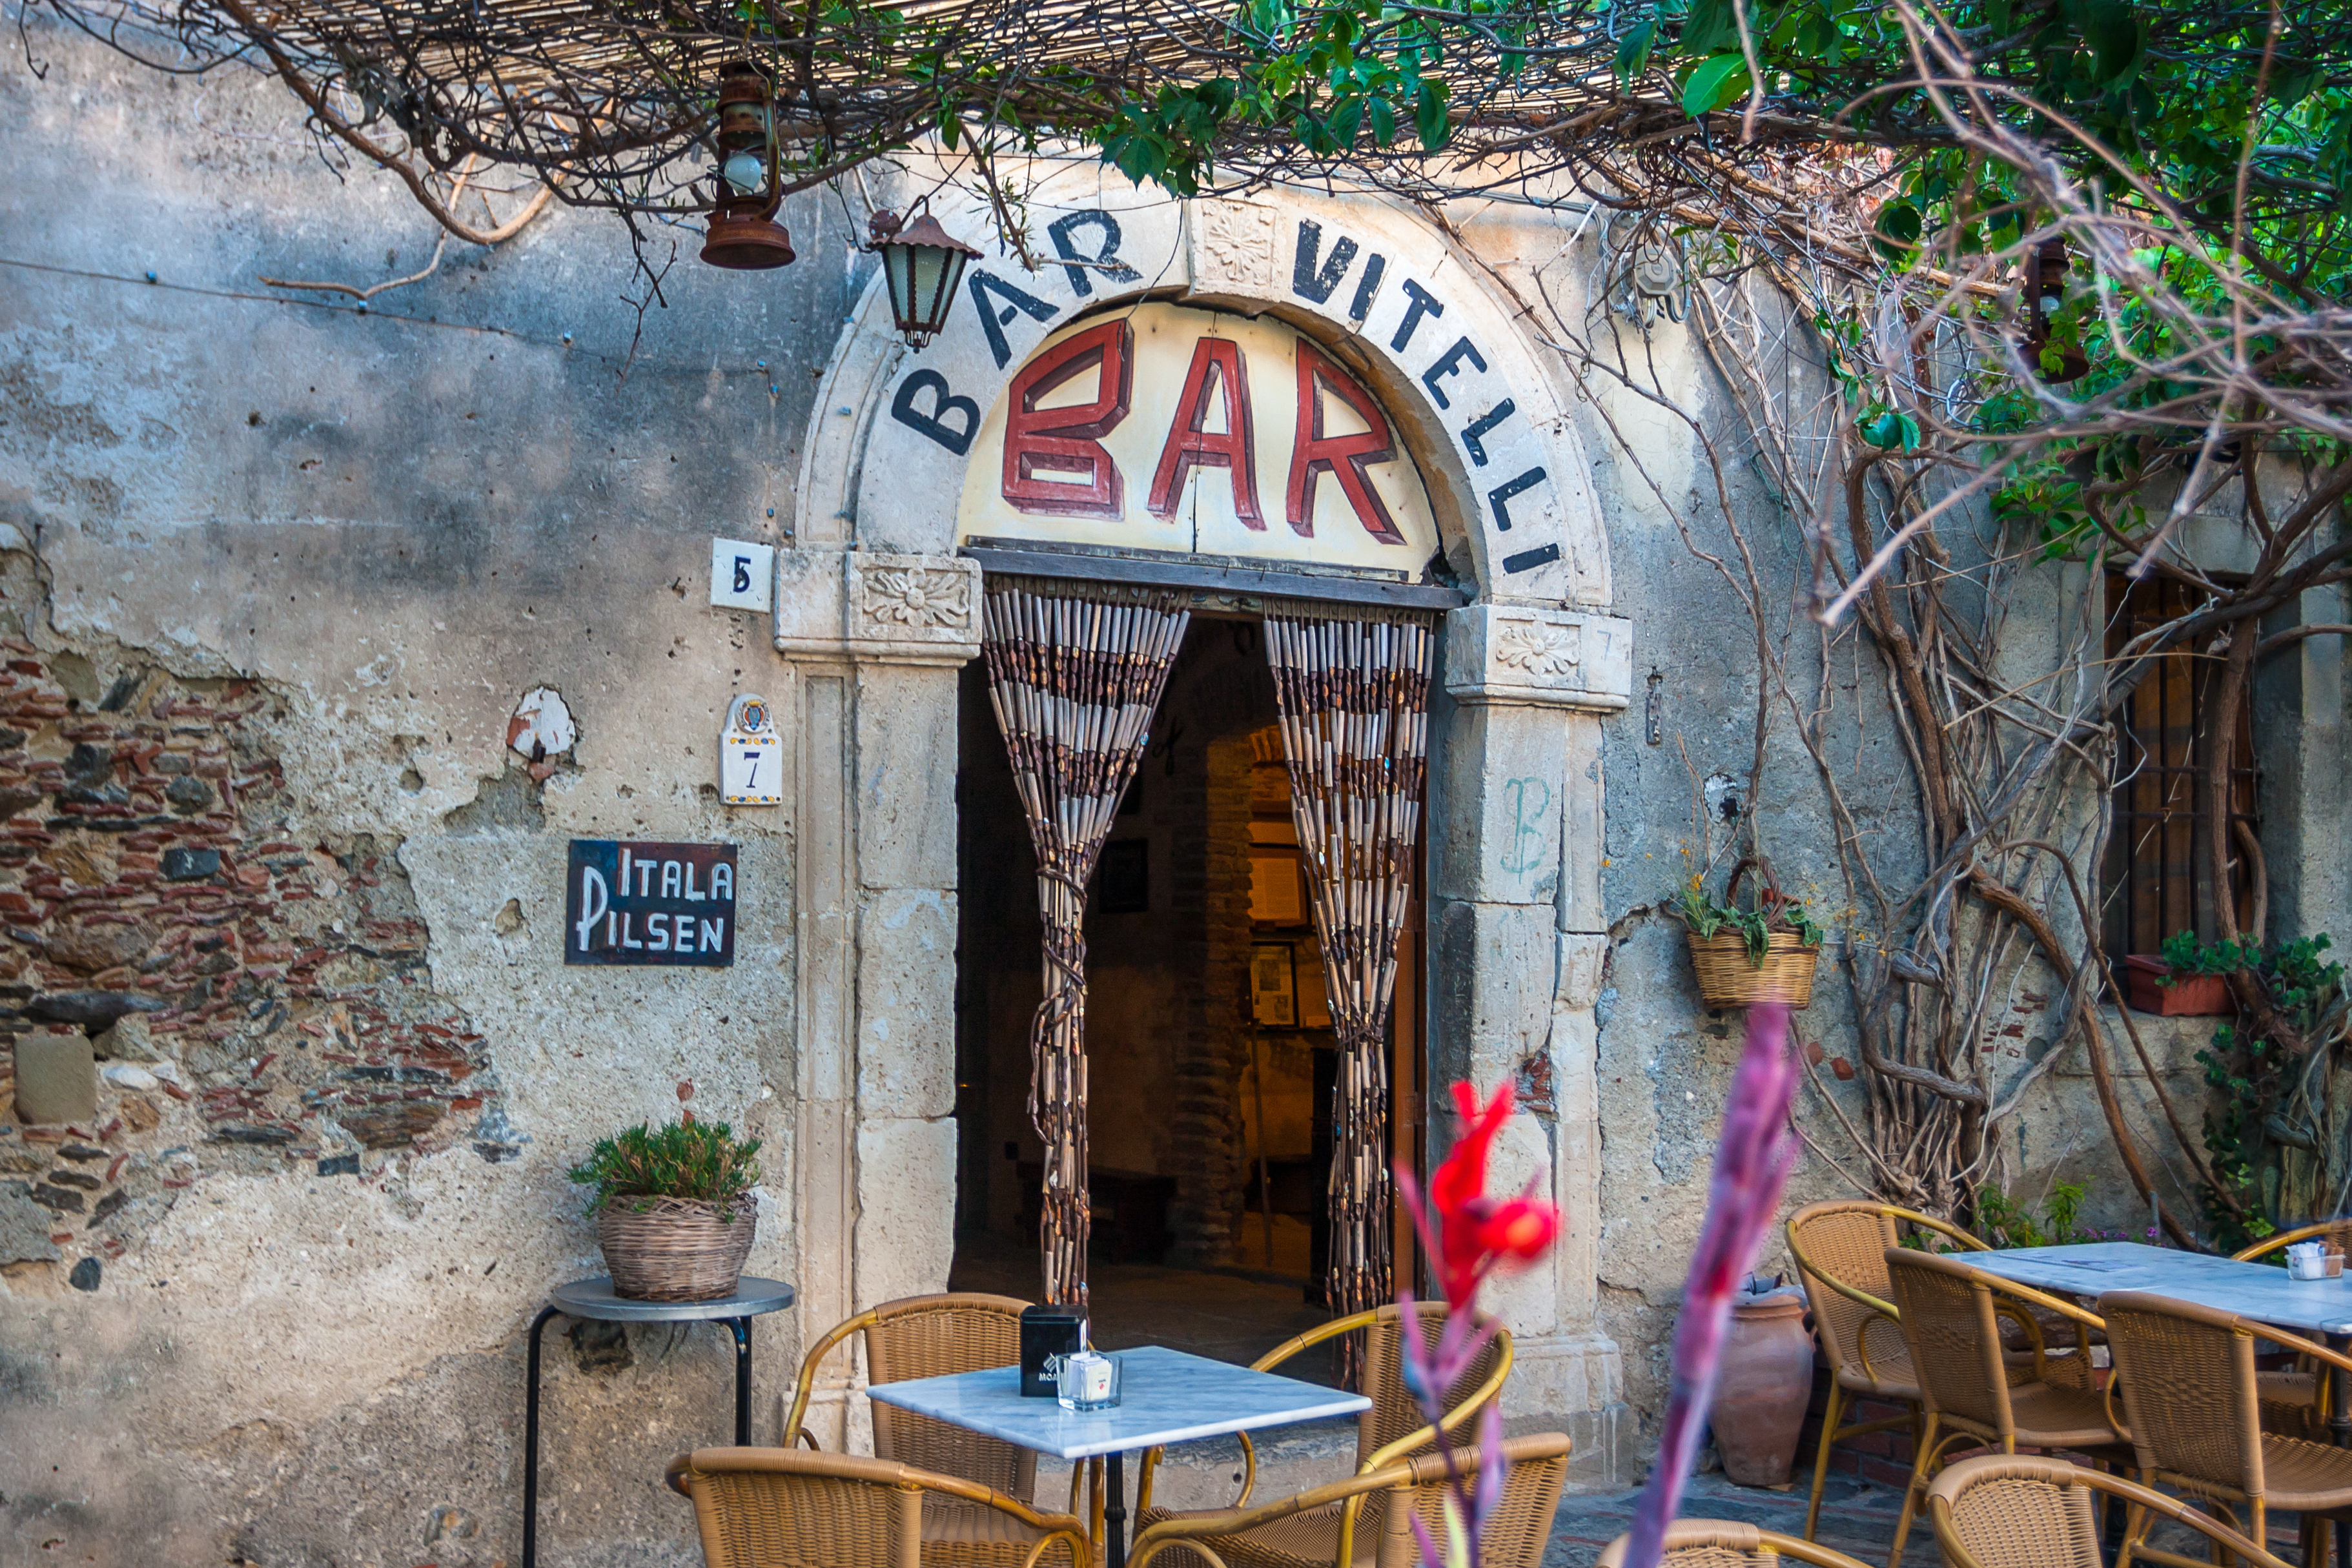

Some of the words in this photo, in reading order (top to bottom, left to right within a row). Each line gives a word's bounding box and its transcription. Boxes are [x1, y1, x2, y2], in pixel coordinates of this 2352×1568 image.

[891, 210, 1143, 456] BAR
[1292, 218, 1560, 575] VITELLI
[1001, 318, 1407, 546] BAR
[733, 556, 751, 593] 5
[743, 752, 761, 789] 7
[577, 866, 723, 952] PILSEN
[617, 848, 733, 901] ITALA
